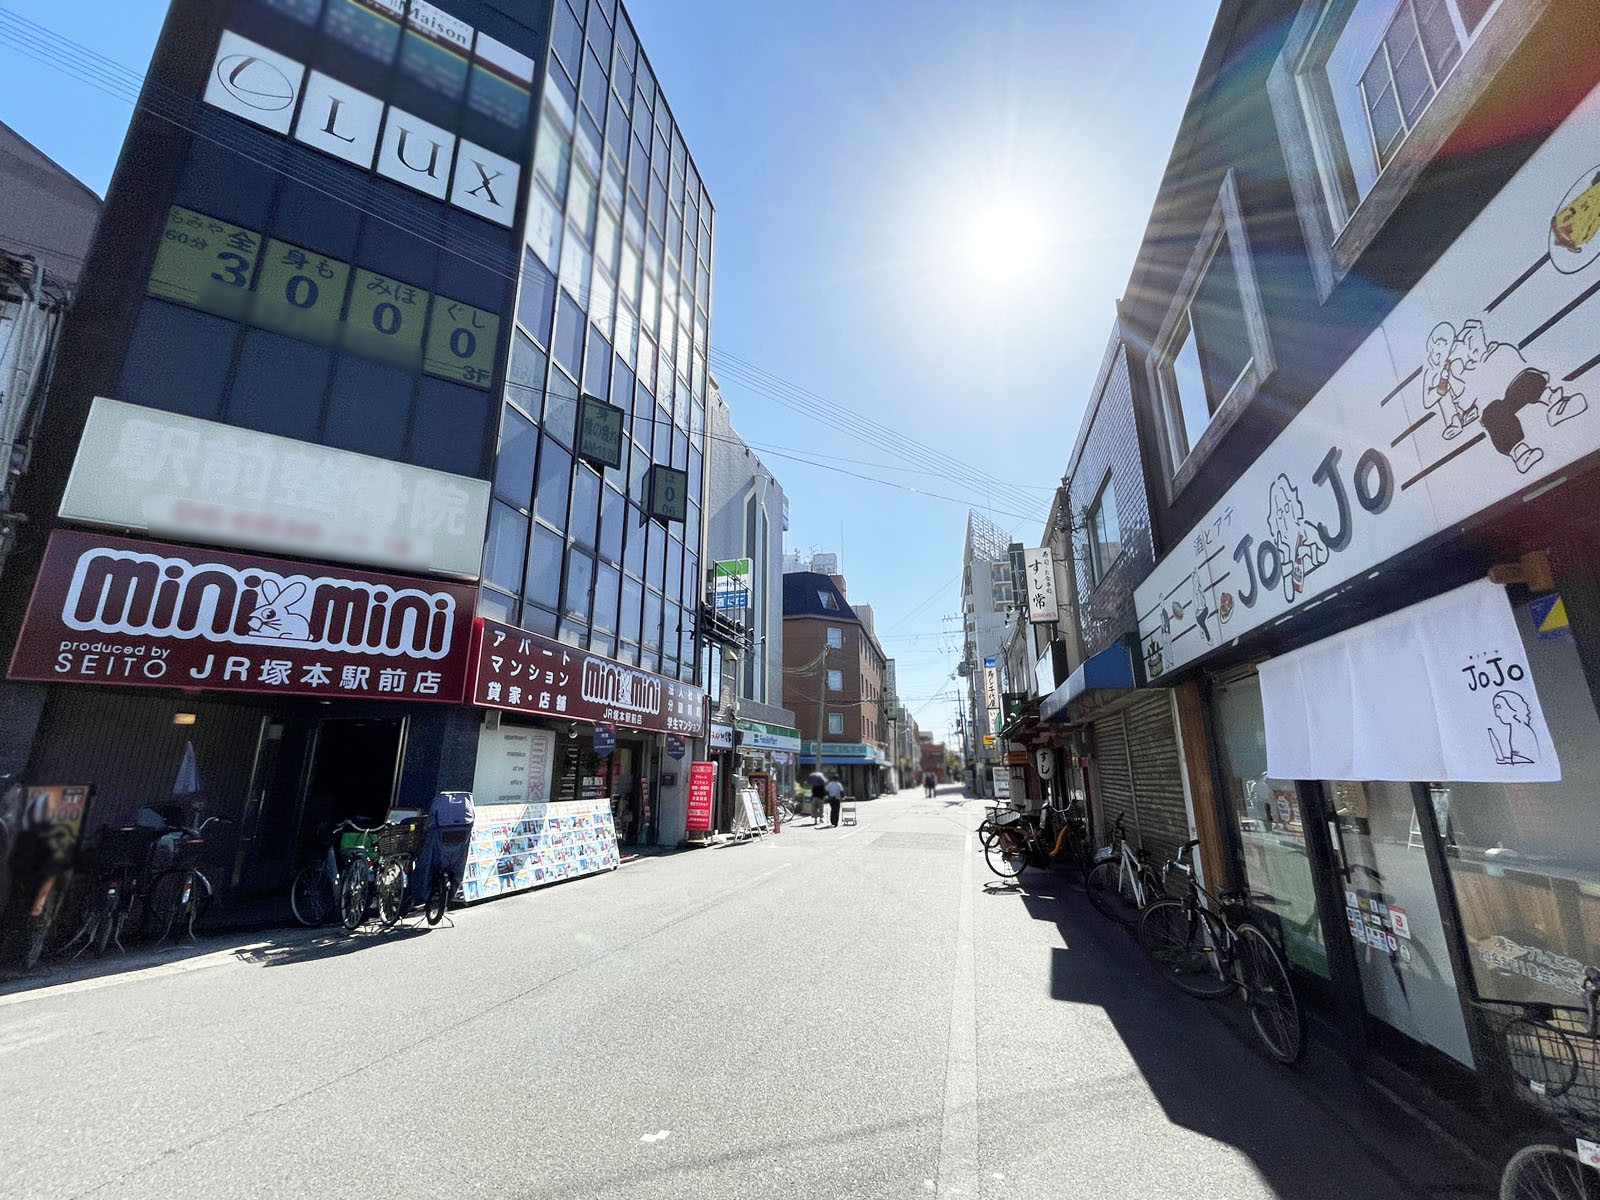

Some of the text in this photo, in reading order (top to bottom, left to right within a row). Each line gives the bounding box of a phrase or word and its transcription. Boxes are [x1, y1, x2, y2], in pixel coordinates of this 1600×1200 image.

[462, 365, 490, 384] 3F
[1028, 559, 1046, 610] すし常
[60, 640, 171, 659] produced by
[493, 630, 570, 666] アパート
[54, 653, 168, 680] SEITO
[190, 653, 443, 695] JR塚本駅前店
[491, 655, 569, 687] マンション
[1039, 751, 1050, 774] すし
